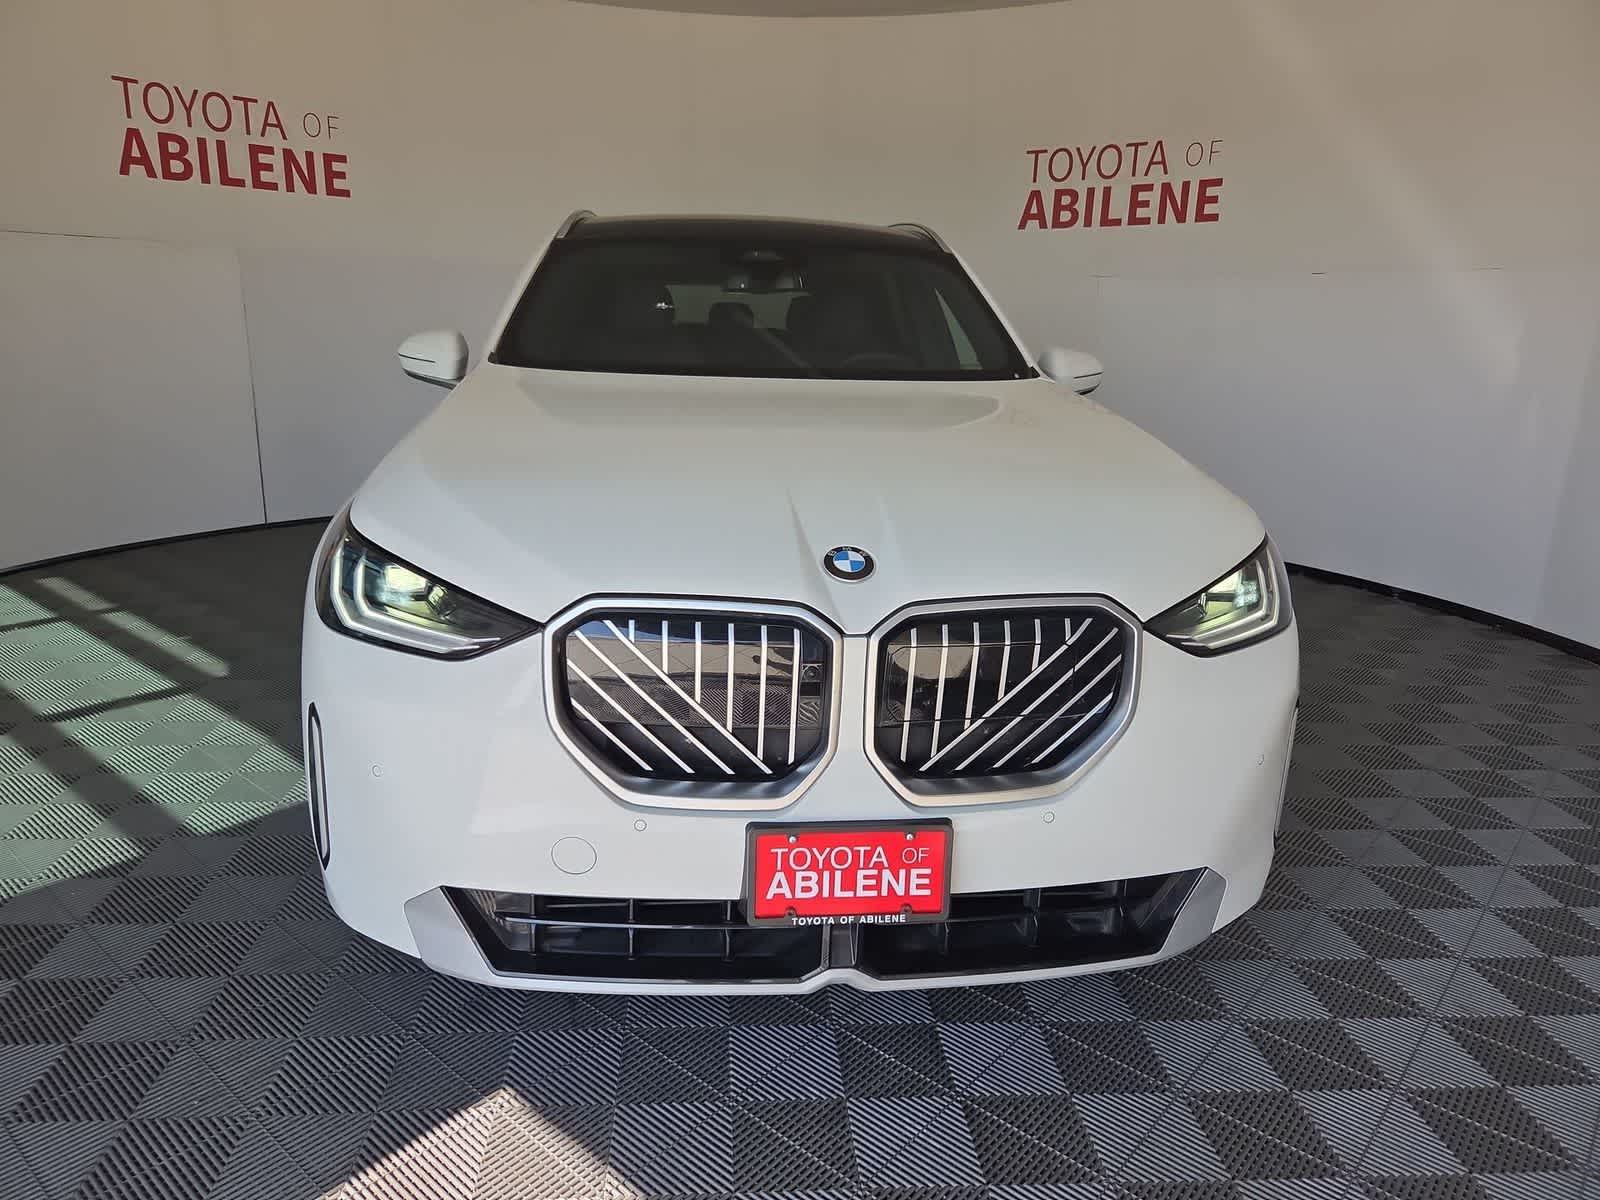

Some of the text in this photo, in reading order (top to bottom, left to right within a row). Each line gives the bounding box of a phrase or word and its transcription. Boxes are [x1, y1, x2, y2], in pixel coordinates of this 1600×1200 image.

[111, 75, 340, 141] TOYOTA OF
[119, 127, 351, 198] ABILENE
[1026, 139, 1223, 183] TOYOTA OF
[1017, 178, 1223, 230] ABILENE
[770, 846, 929, 870] TOYOTA OF
[765, 868, 932, 900] ABILENE
[791, 914, 906, 926] TOYOTA OF ABILENE
